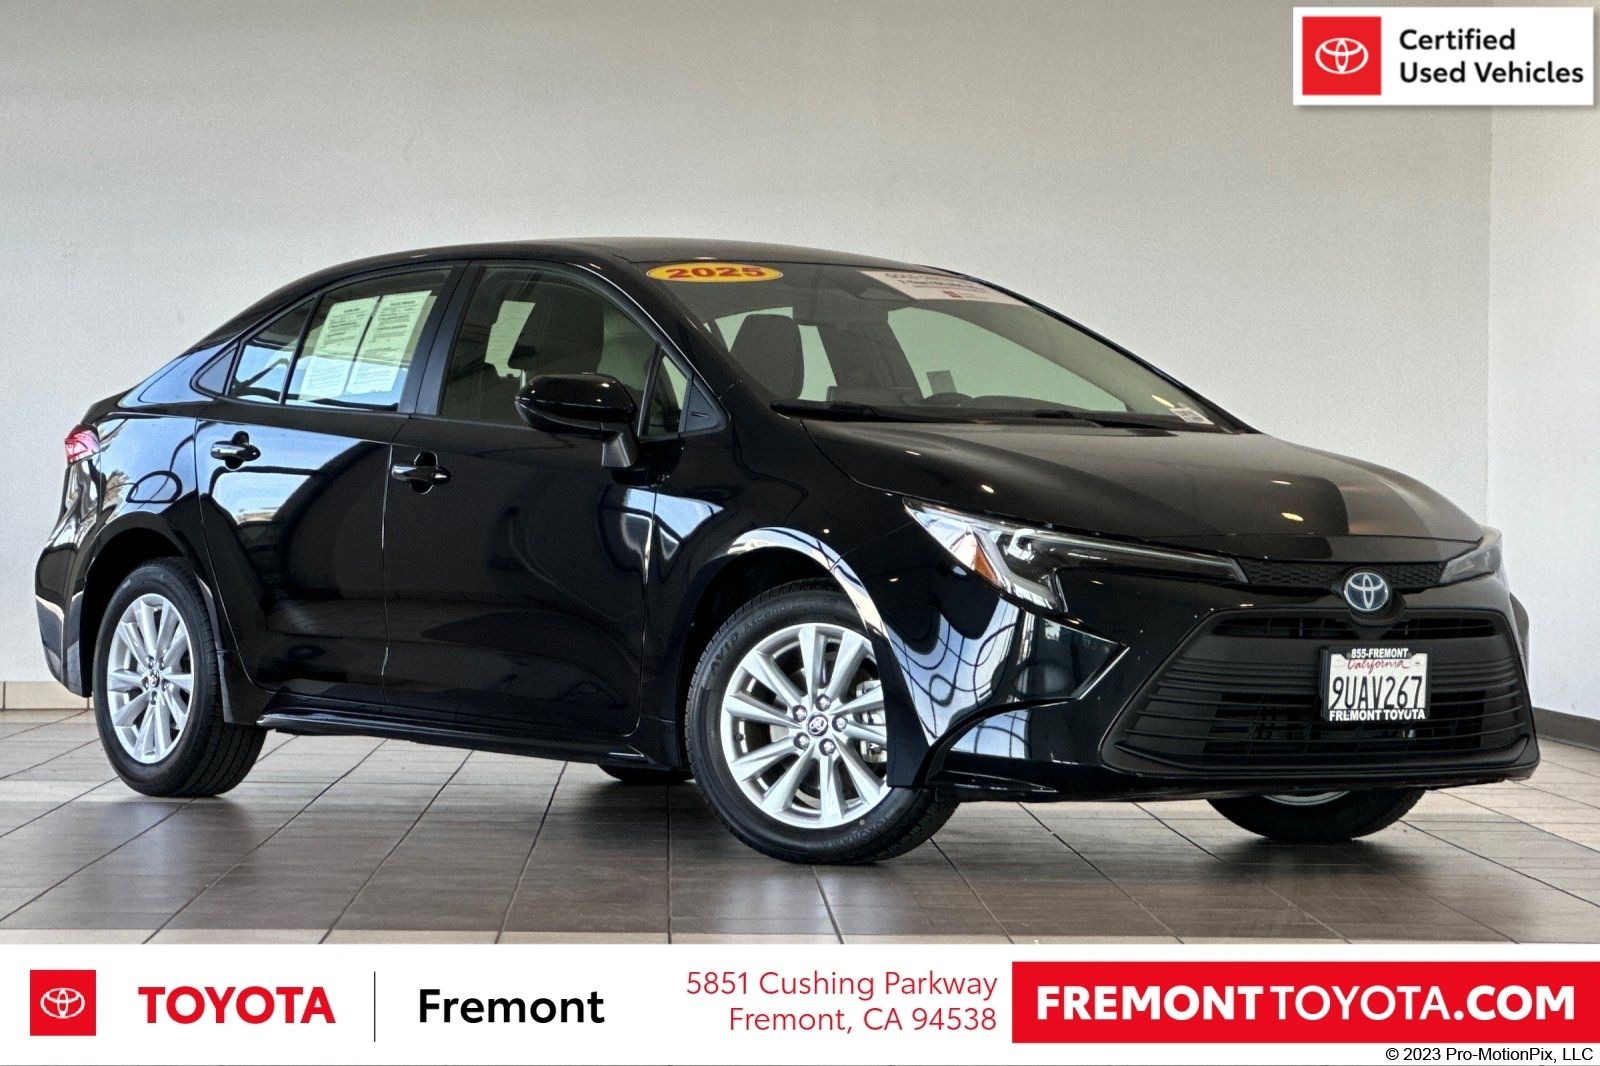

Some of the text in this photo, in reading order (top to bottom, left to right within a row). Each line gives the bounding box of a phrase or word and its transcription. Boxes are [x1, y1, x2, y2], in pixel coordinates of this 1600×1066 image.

[665, 267, 765, 279] 2025
[1351, 648, 1409, 659] 855-FREMONT
[1347, 660, 1411, 675] California
[1329, 676, 1423, 709] 9UAV267
[1329, 708, 1426, 721] FREMONT TOYOTA
